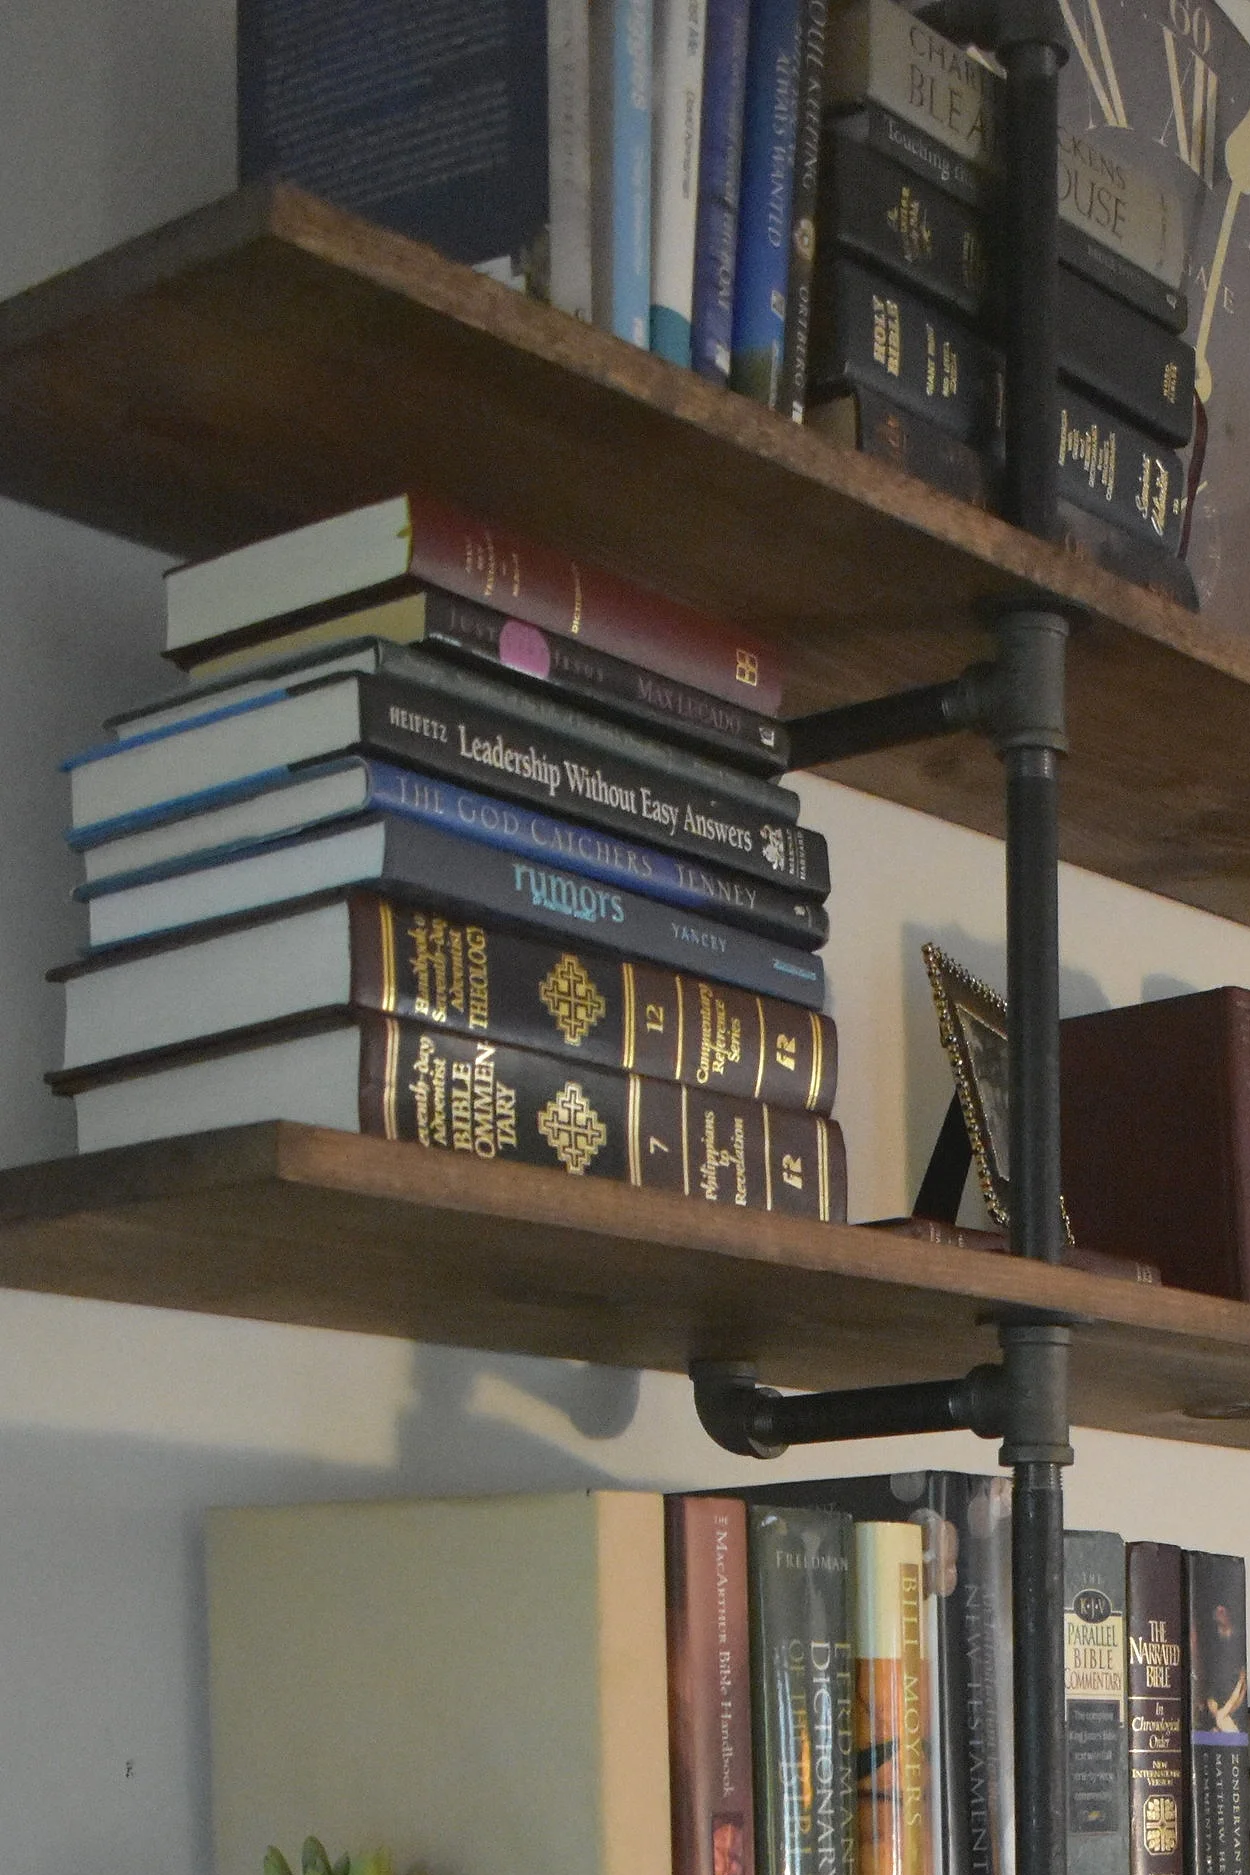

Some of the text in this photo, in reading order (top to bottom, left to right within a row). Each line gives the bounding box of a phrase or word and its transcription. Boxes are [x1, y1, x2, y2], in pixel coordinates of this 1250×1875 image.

[872, 294, 886, 364] HOLY
[885, 299, 900, 377] BIBLE
[389, 705, 754, 853] HEIFETZ Leadership Without Easy Answers
[397, 775, 757, 911] THE GOD CATCHERS TENNEY
[513, 862, 626, 924] rumors
[670, 921, 728, 954] YANCEY
[646, 1004, 666, 1034] 12
[696, 982, 714, 1085] Commentary
[712, 998, 727, 1076] Reference
[726, 1016, 742, 1064] Series
[451, 1061, 473, 1151] BIBLE
[496, 1080, 518, 1149] TARY
[729, 1116, 748, 1207] Revelation
[1067, 1622, 1118, 1648] PARALLEL
[1073, 1648, 1114, 1670] BIBLE
[1129, 1636, 1181, 1666] NARRATED
[1148, 1620, 1168, 1643] THE
[718, 1650, 732, 1696] Bible
[901, 1575, 921, 1827] BILL MOYERS
[1064, 1667, 1122, 1691] COMMENTARY
[1145, 1666, 1172, 1689] BIBLE
[719, 1701, 736, 1799] Handbook
[964, 1584, 990, 1874] NEW TESTAMENT
[1148, 1732, 1170, 1750] Order
[1214, 1753, 1228, 1846] MATTHEW
[1229, 1753, 1243, 1856] ZONDERVAN
